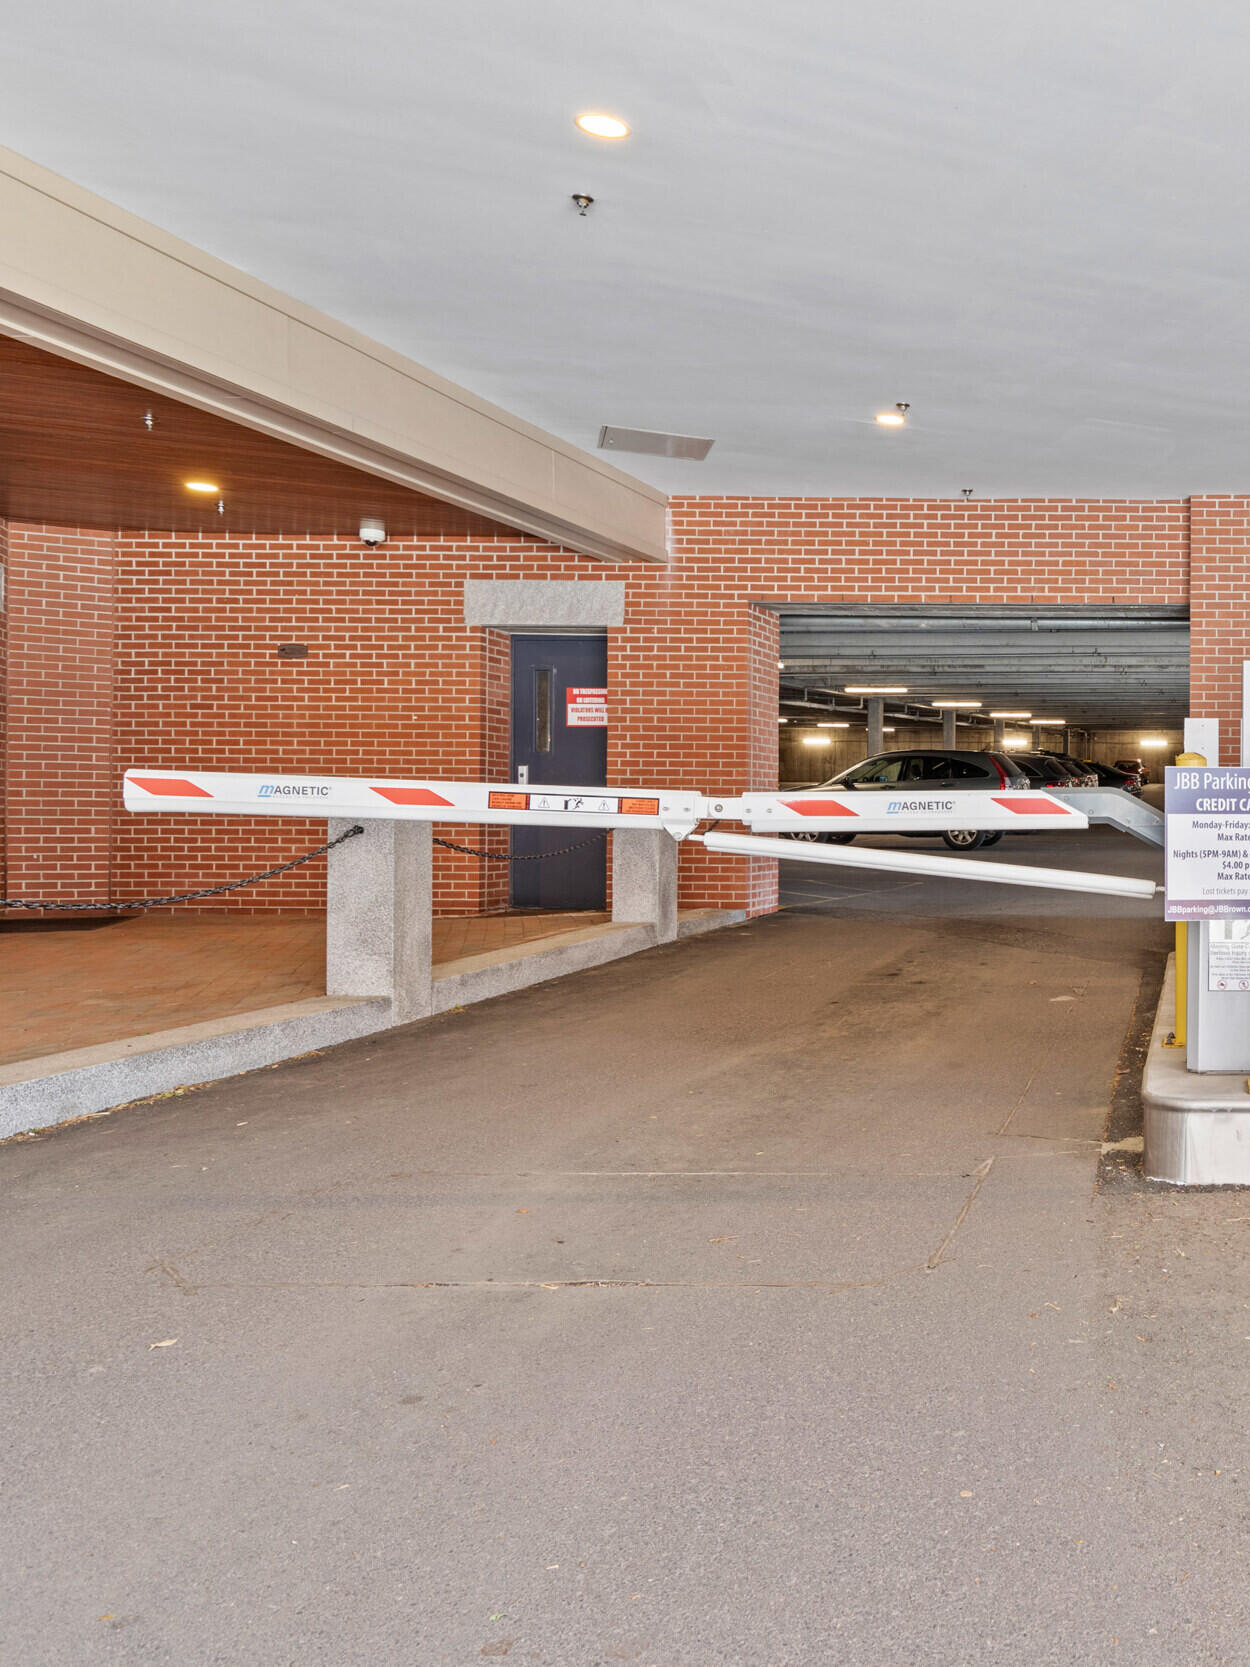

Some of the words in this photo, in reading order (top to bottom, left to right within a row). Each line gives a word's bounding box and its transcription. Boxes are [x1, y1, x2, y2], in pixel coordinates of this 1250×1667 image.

[1174, 772, 1200, 790] JBB
[1196, 798, 1237, 812] CREDIT
[1218, 832, 1232, 840] Max
[1173, 850, 1198, 860] Nights
[1200, 850, 1241, 860] (5PM-9AM)
[1242, 850, 1248, 858] &
[1222, 861, 1243, 870] $4.00
[1218, 872, 1233, 880] Max
